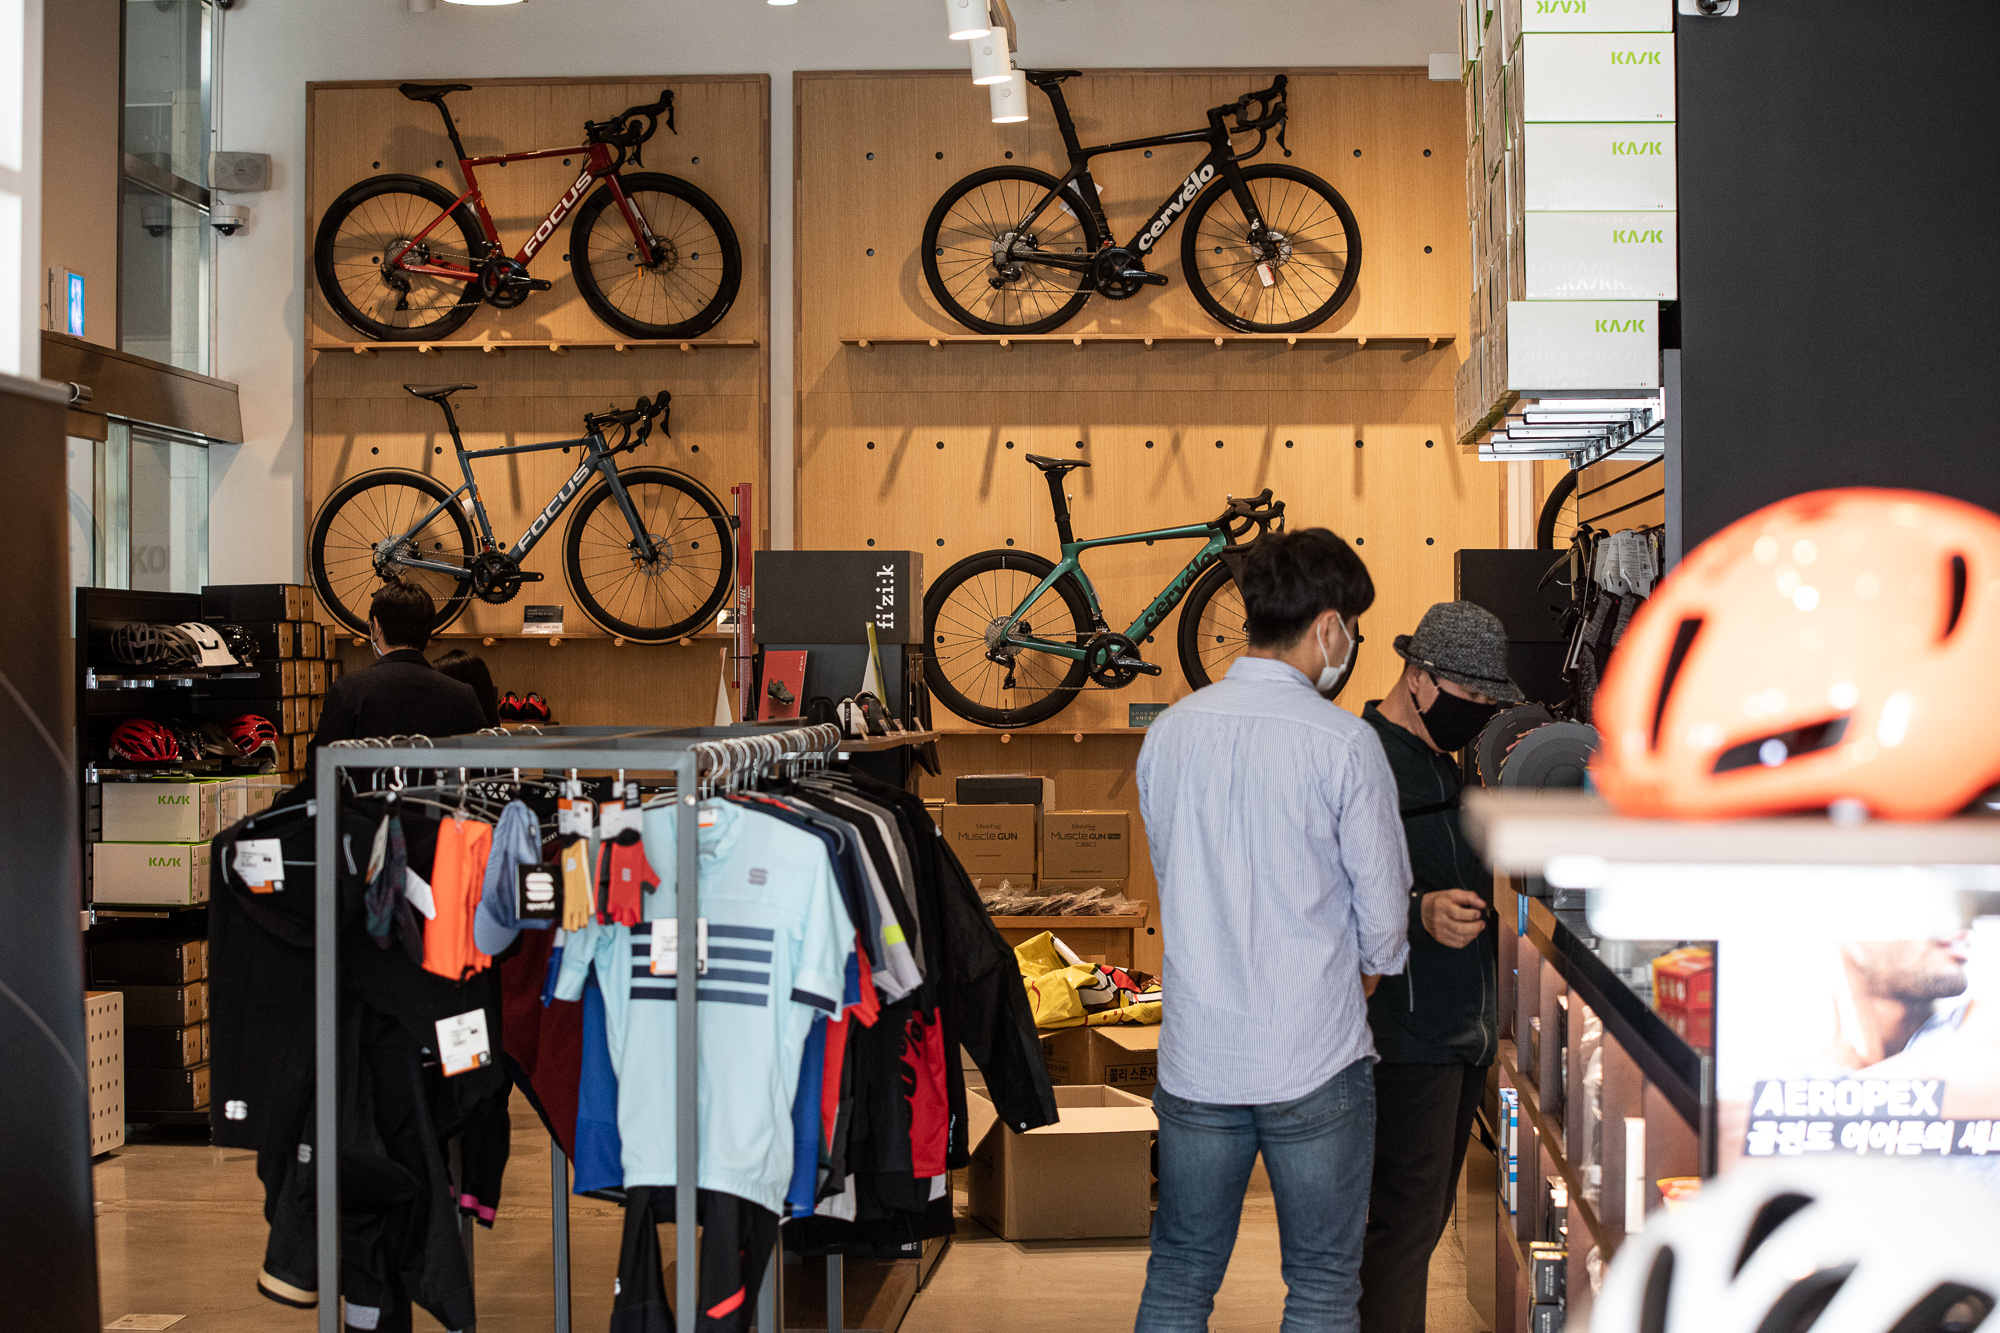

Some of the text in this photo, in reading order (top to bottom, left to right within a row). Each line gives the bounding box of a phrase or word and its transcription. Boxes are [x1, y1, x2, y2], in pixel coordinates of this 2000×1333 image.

[1611, 51, 1661, 65] KASK
[1612, 141, 1662, 155] KASK
[523, 170, 593, 258] FOCUS
[1138, 163, 1215, 251] cervélo
[1613, 230, 1663, 243] KASK
[1595, 319, 1645, 333] KASK
[517, 463, 590, 553] FOCUS
[114, 744, 132, 761] KASK
[158, 795, 190, 805] KASK
[958, 831, 1018, 841] Muscle GUN
[1051, 831, 1088, 840] Muscle
[149, 857, 181, 867] KASK
[1130, 1065, 1157, 1081] 스폰지
[1752, 1079, 1940, 1117] AEROPEX
[1840, 1119, 1955, 1156] 이어폰의
